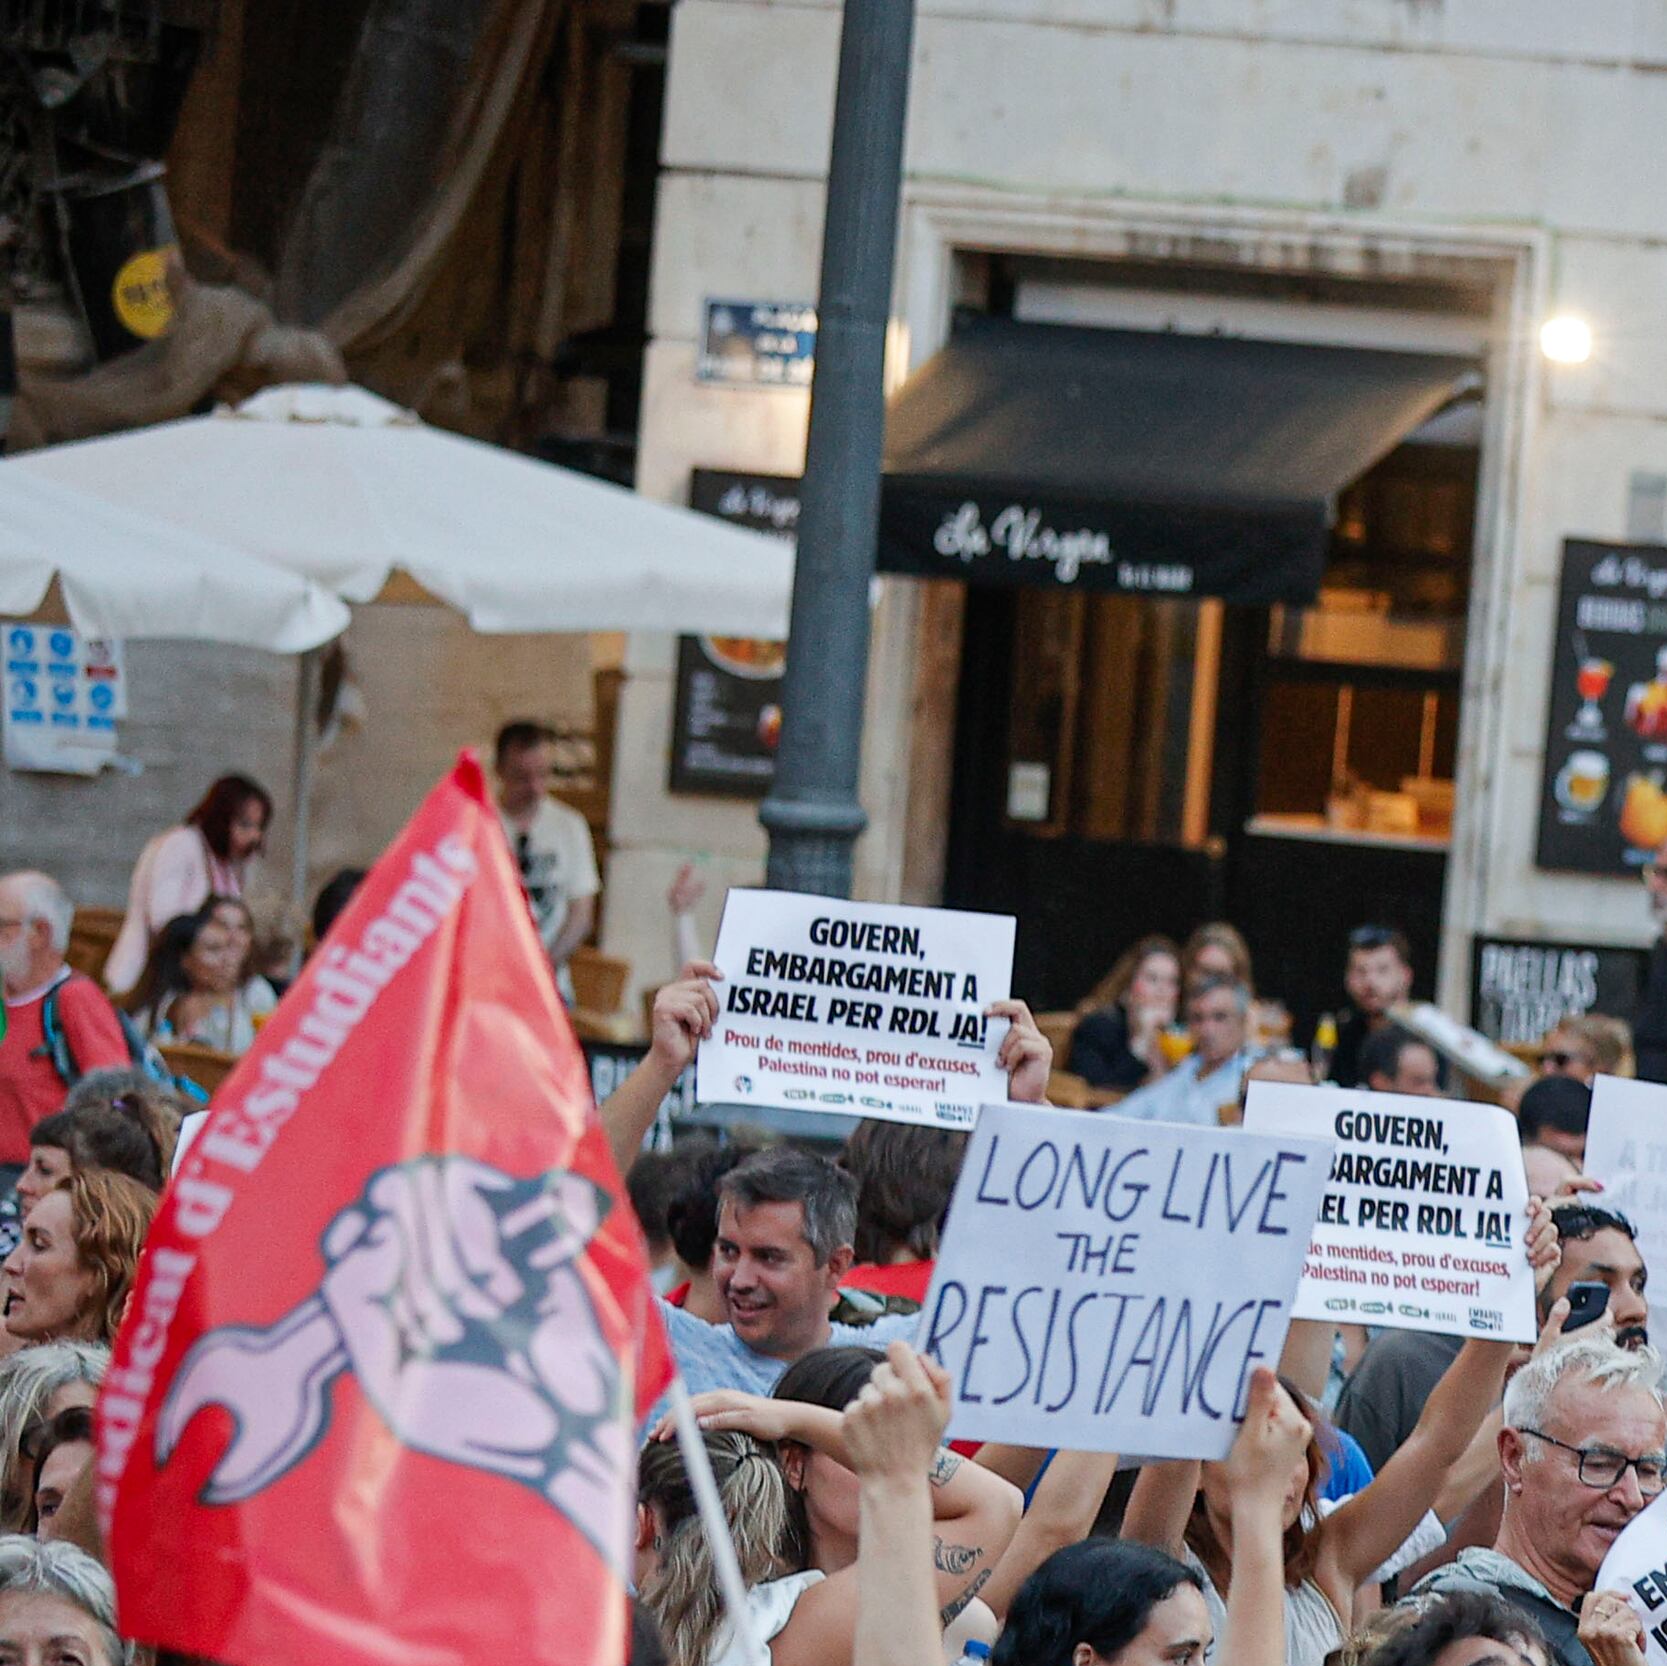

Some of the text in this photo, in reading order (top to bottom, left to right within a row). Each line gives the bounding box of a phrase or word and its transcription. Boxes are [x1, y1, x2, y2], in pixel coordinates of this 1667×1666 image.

[809, 917, 925, 961] GOVERN,
[746, 948, 978, 1002] EMBARGAMENT A
[726, 985, 988, 1043] ISRAEL PER RDL JA!
[1335, 1110, 1449, 1155] GOVERN,
[976, 1135, 1306, 1235] LONG LIVE
[1486, 1169, 1504, 1200] A
[1359, 1200, 1512, 1242] PER RDL JA!
[1056, 1233, 1139, 1274] THE
[928, 1280, 1281, 1425] RESISTANCE
